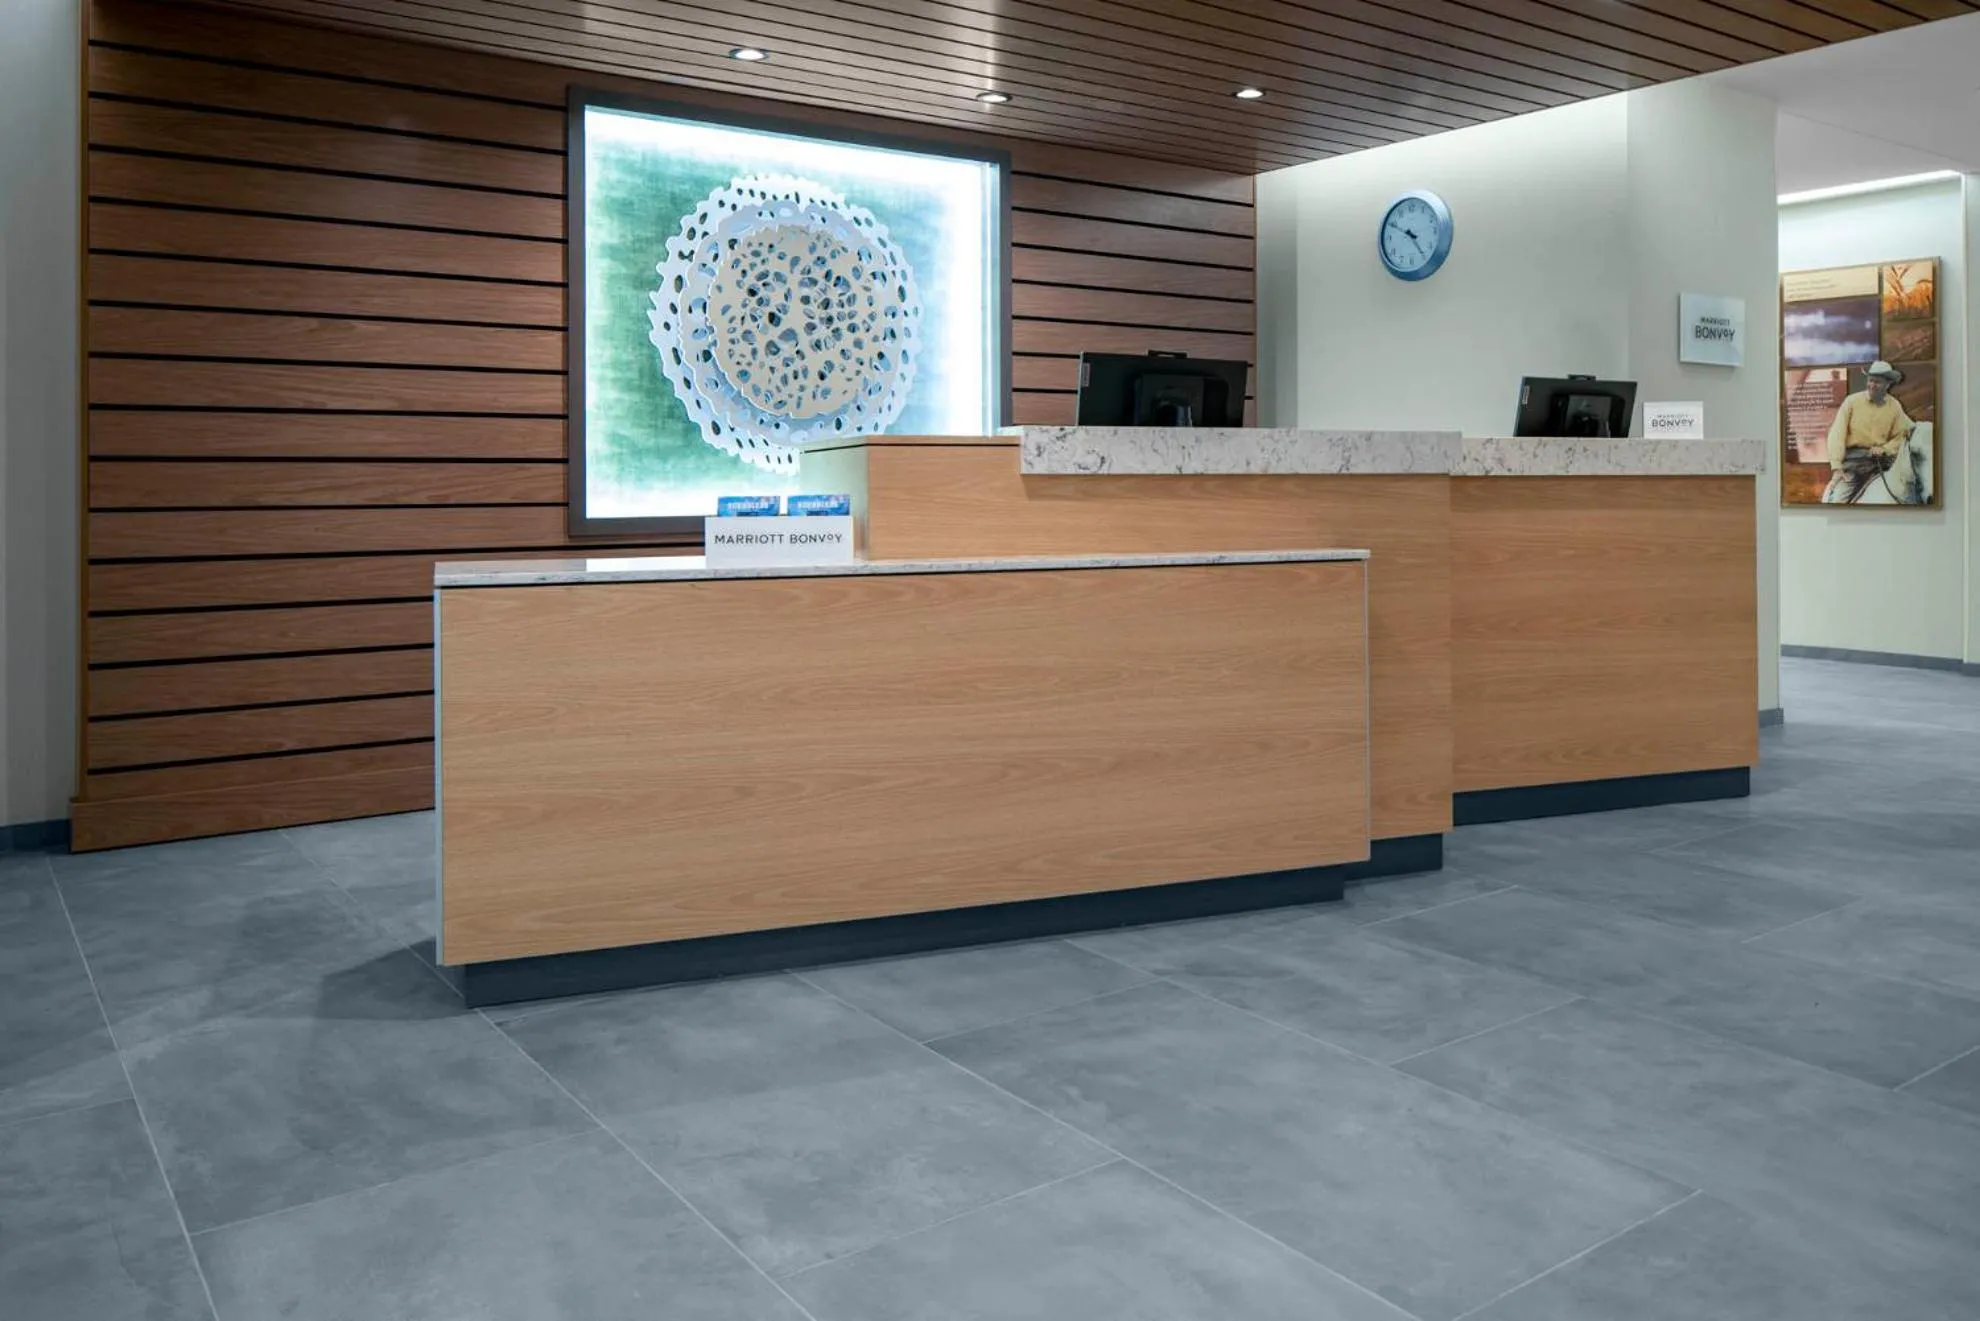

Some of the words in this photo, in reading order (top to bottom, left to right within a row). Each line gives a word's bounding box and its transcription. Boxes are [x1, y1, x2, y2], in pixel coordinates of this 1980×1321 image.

[1695, 325, 1735, 342] BONVOY
[713, 533, 785, 545] MARRIOTT
[789, 533, 843, 544] BONVOY
